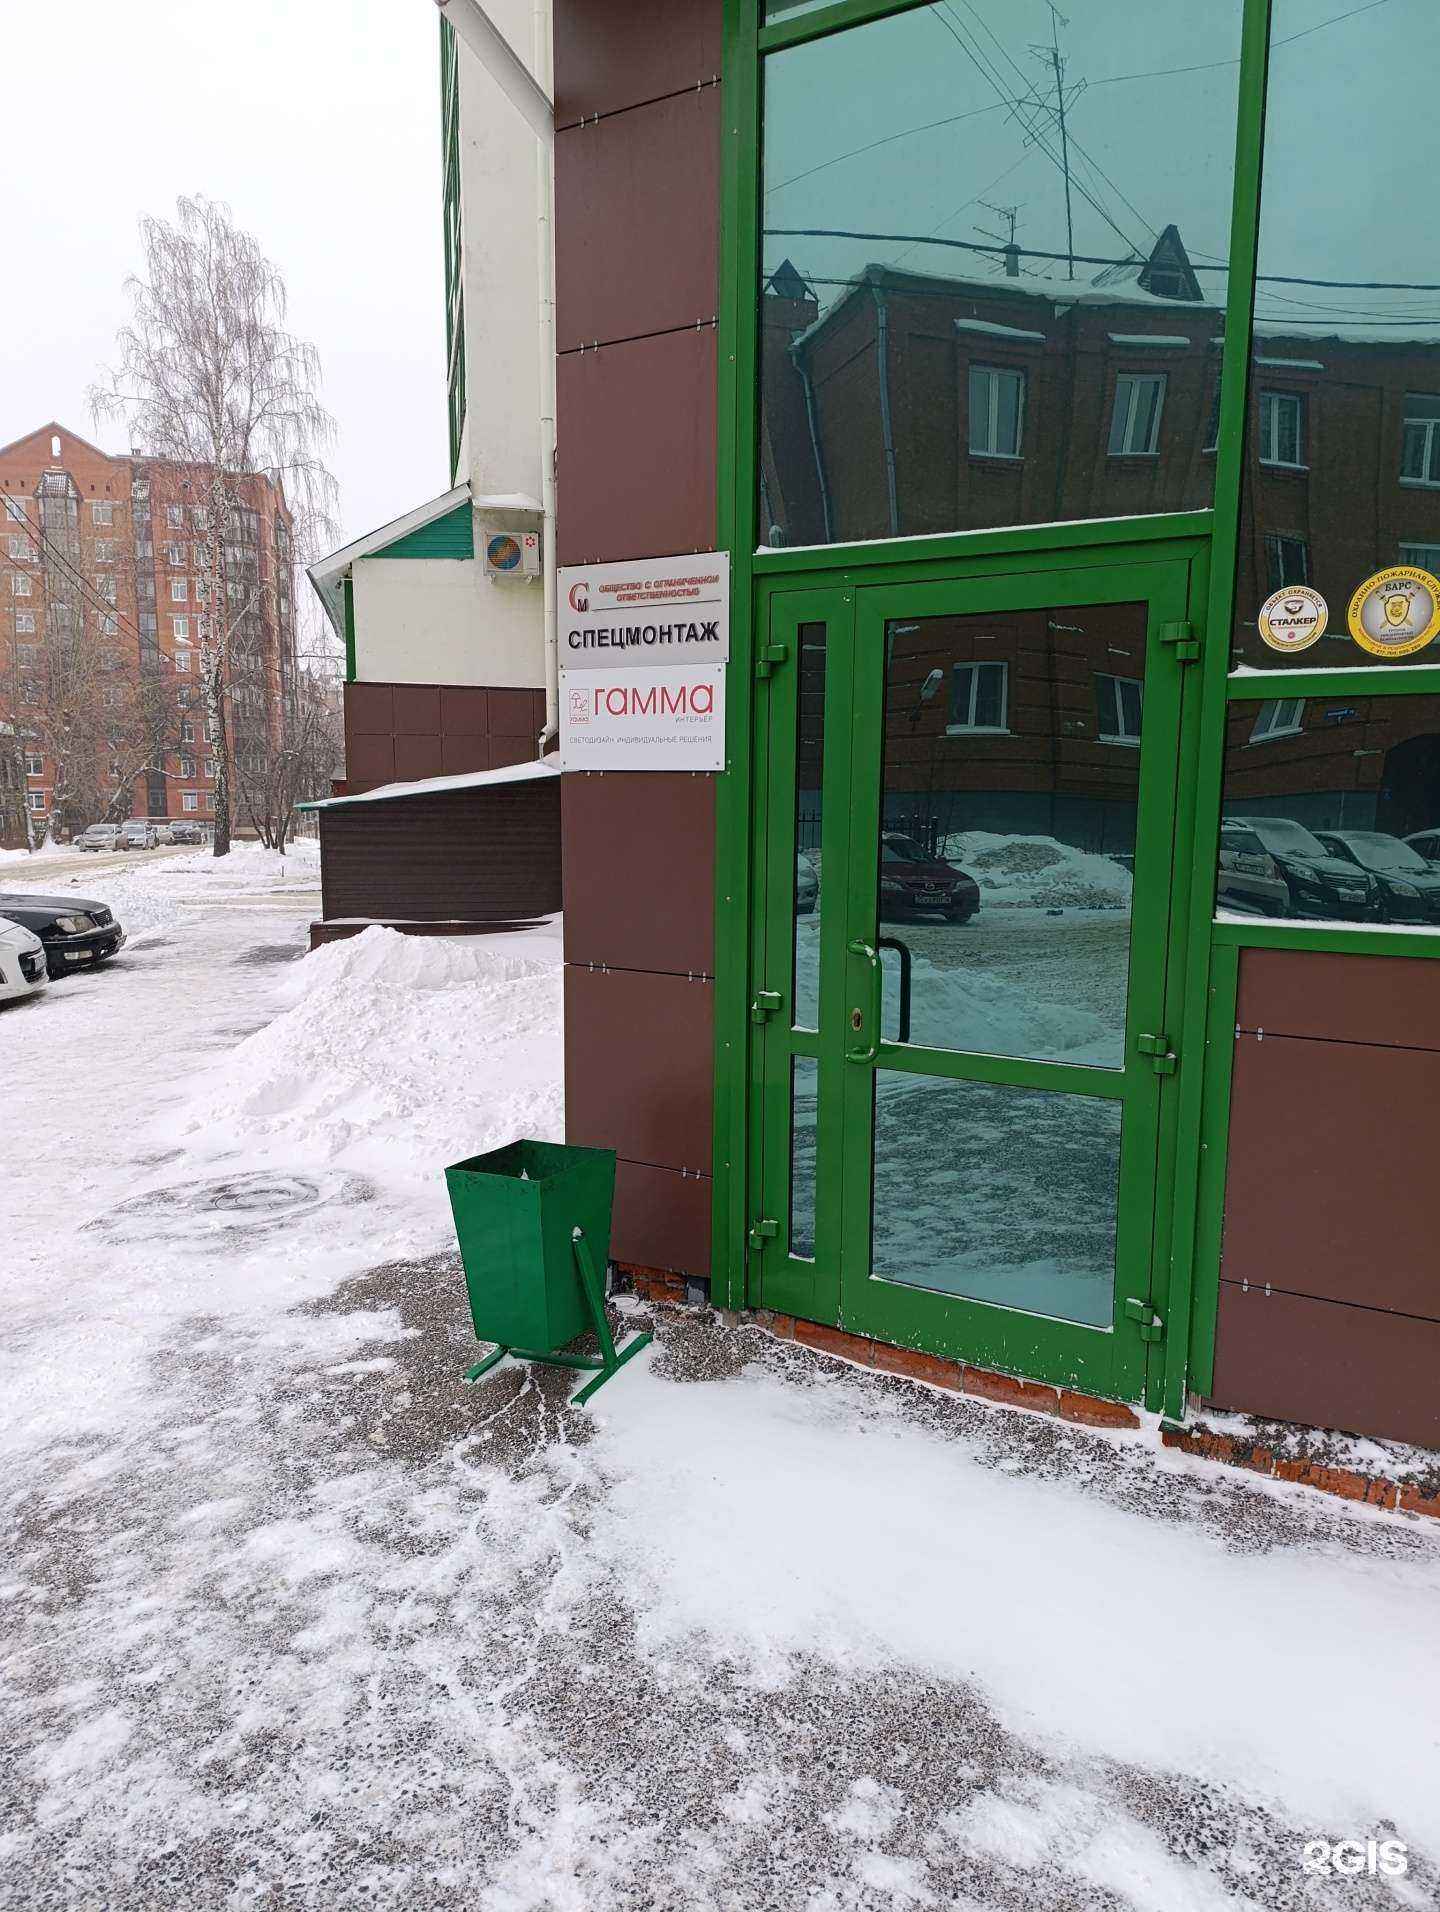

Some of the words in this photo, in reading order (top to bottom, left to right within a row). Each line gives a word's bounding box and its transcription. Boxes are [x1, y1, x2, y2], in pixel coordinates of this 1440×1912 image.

[598, 583, 642, 594] ОБЩЕСТВО
[653, 574, 720, 589] ОГРАНИЧЕННОЙ
[1385, 581, 1412, 592] БАРС
[616, 587, 700, 602] ОТВЕТСТВЕННОСТЬЮ
[1269, 617, 1317, 626] СТАЛКЕР
[568, 620, 720, 650] СПЕЦМОНТАЖ
[593, 684, 714, 716] гамма
[617, 735, 678, 745] ИНДИВИДУАЛЬНЫЕ
[679, 735, 713, 743] РЕШЕНИЯ
